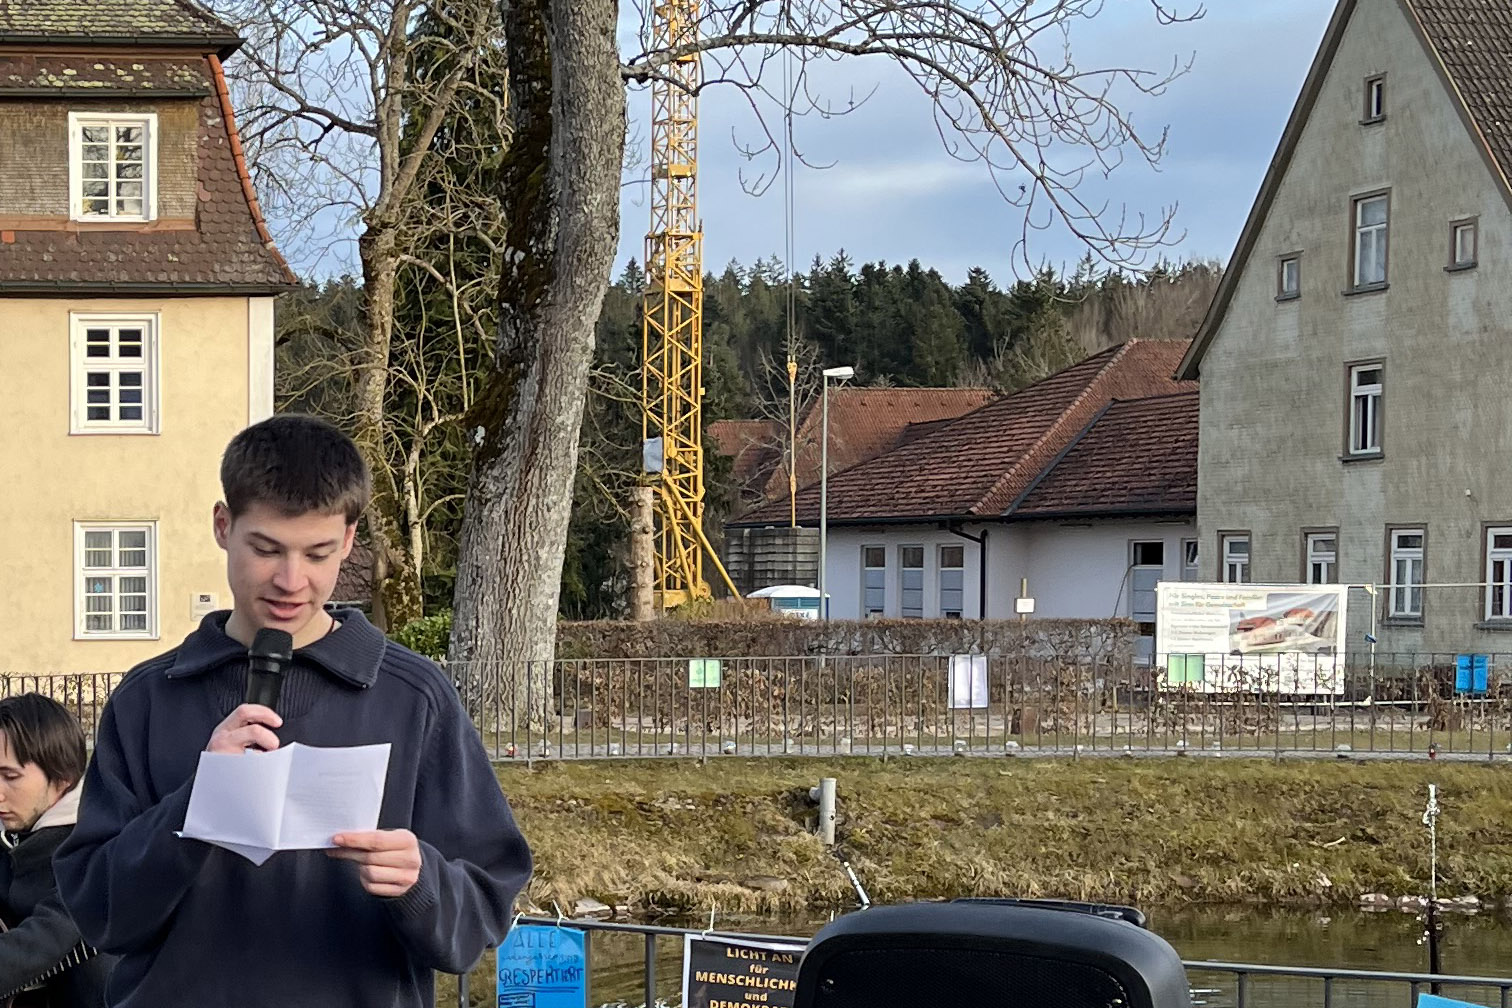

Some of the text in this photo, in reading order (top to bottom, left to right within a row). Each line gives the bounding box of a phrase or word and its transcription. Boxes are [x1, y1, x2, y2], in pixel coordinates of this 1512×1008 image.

[513, 930, 558, 949] ALLE
[726, 947, 793, 964] LICHT AN
[749, 963, 770, 974] für
[744, 992, 768, 1001] und
